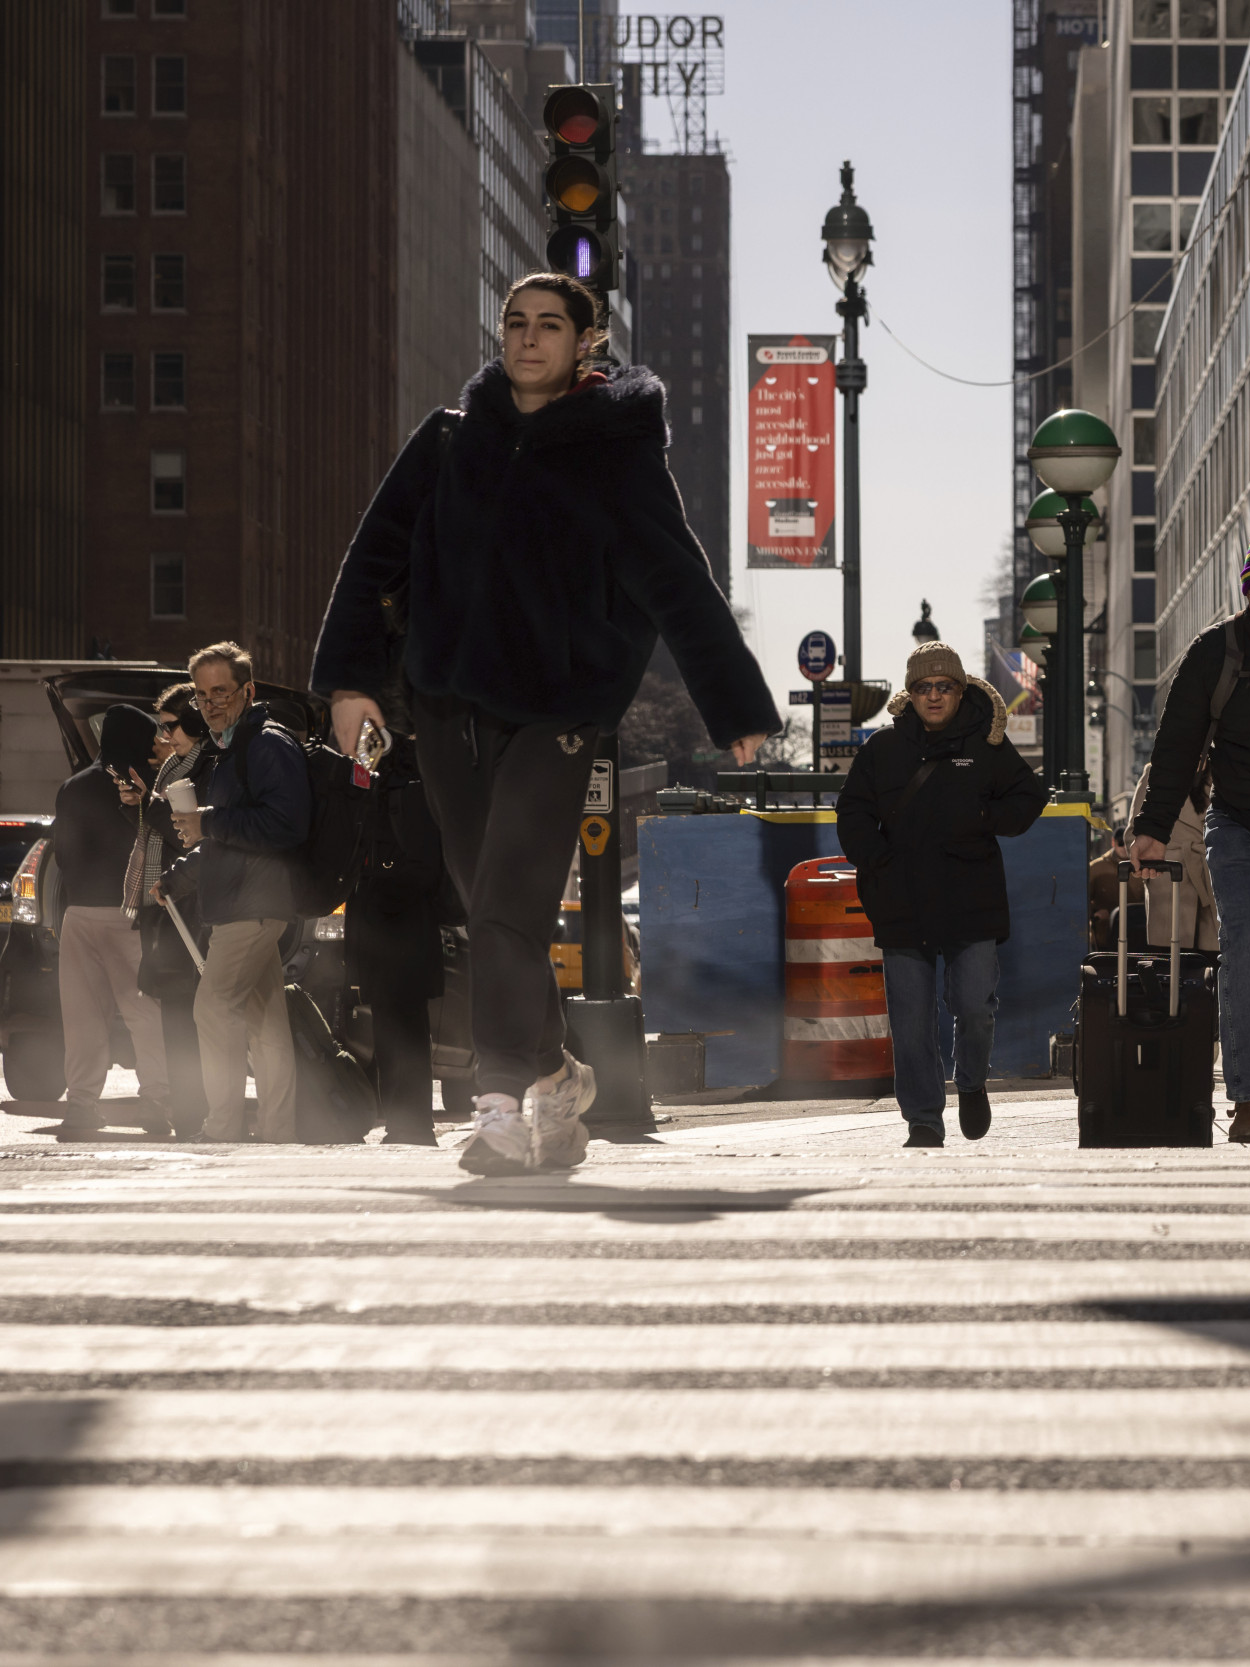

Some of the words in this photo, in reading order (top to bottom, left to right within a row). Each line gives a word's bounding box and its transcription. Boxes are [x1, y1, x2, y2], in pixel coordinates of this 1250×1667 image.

[757, 388, 776, 400] The
[756, 406, 781, 415] most
[756, 418, 808, 430] accessible
[756, 432, 830, 445] neighborhood
[776, 449, 793, 461] got
[755, 465, 784, 475] more
[805, 546, 828, 556] EAST
[820, 746, 858, 757] BUSES
